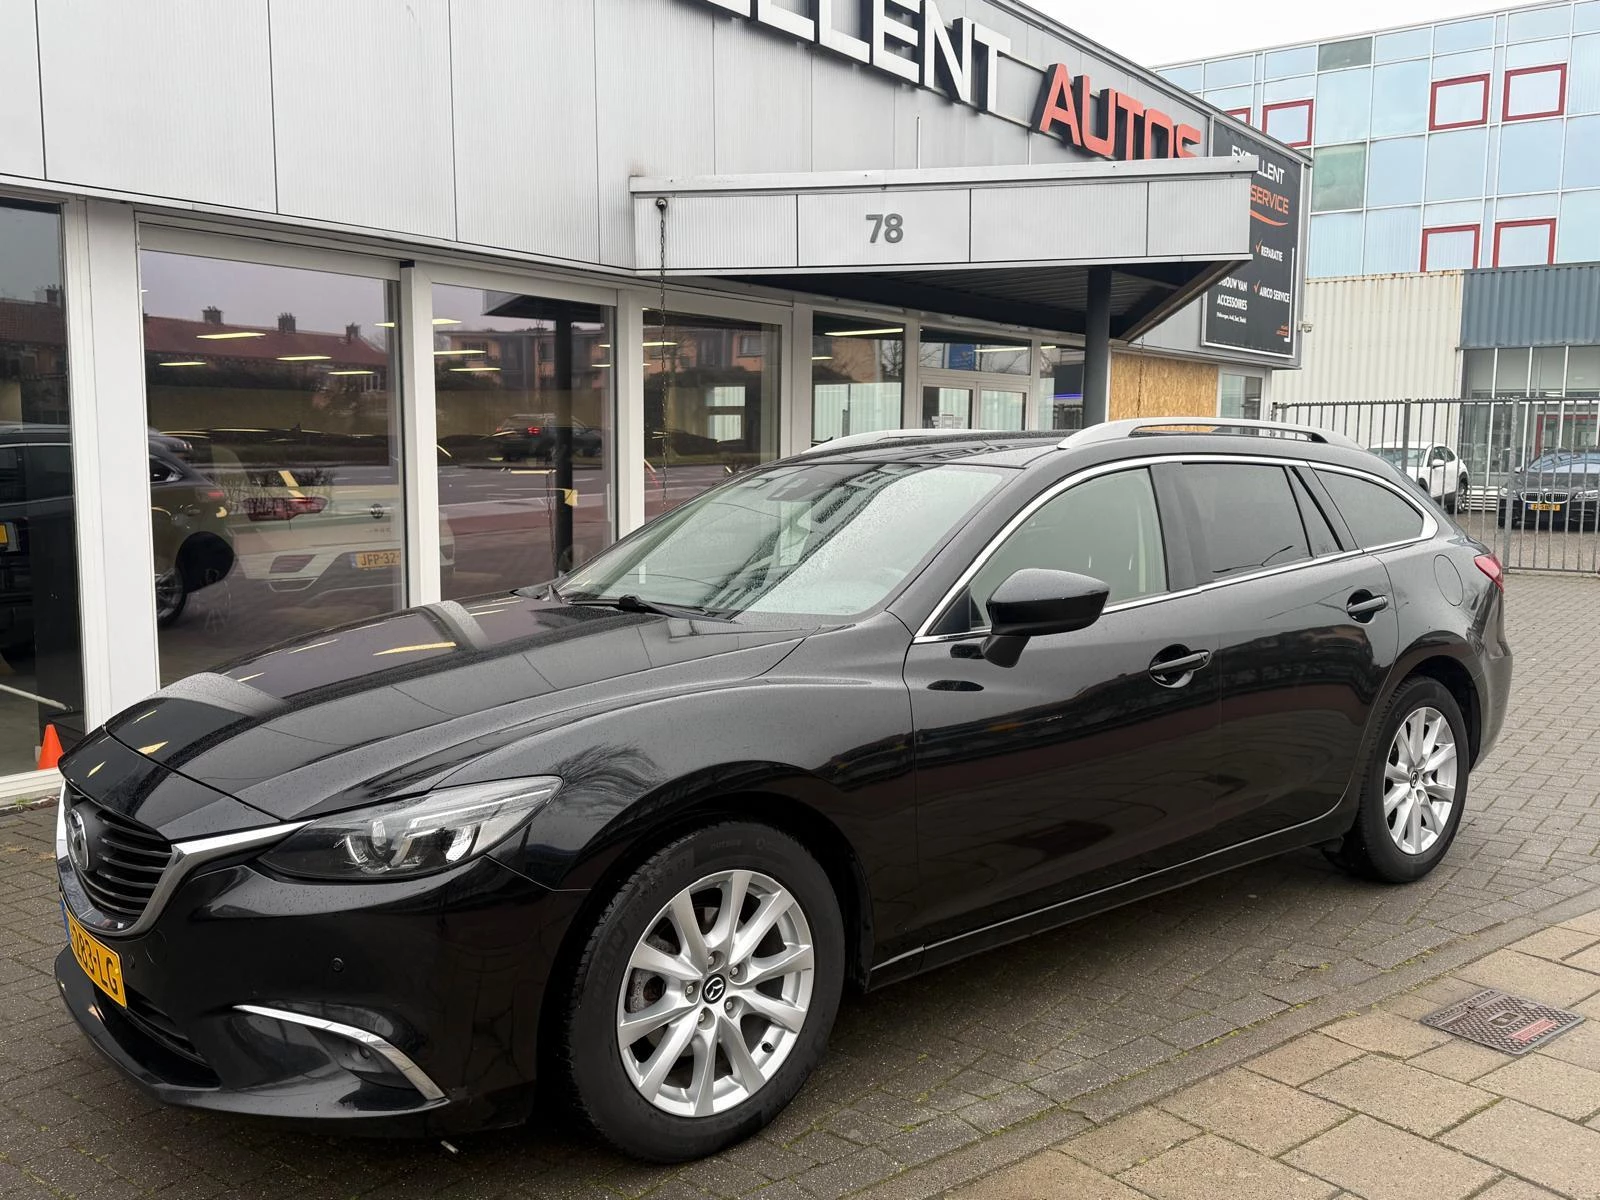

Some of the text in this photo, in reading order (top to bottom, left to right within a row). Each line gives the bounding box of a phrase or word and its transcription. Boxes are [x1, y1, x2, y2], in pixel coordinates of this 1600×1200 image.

[1250, 184, 1289, 215] SERVICE
[865, 213, 904, 244] 78
[1260, 245, 1283, 262] REPARATIE
[1237, 279, 1248, 292] VAN
[1216, 293, 1248, 311] ACCESSOIRES
[1259, 286, 1290, 303] AIRCO SERVICE
